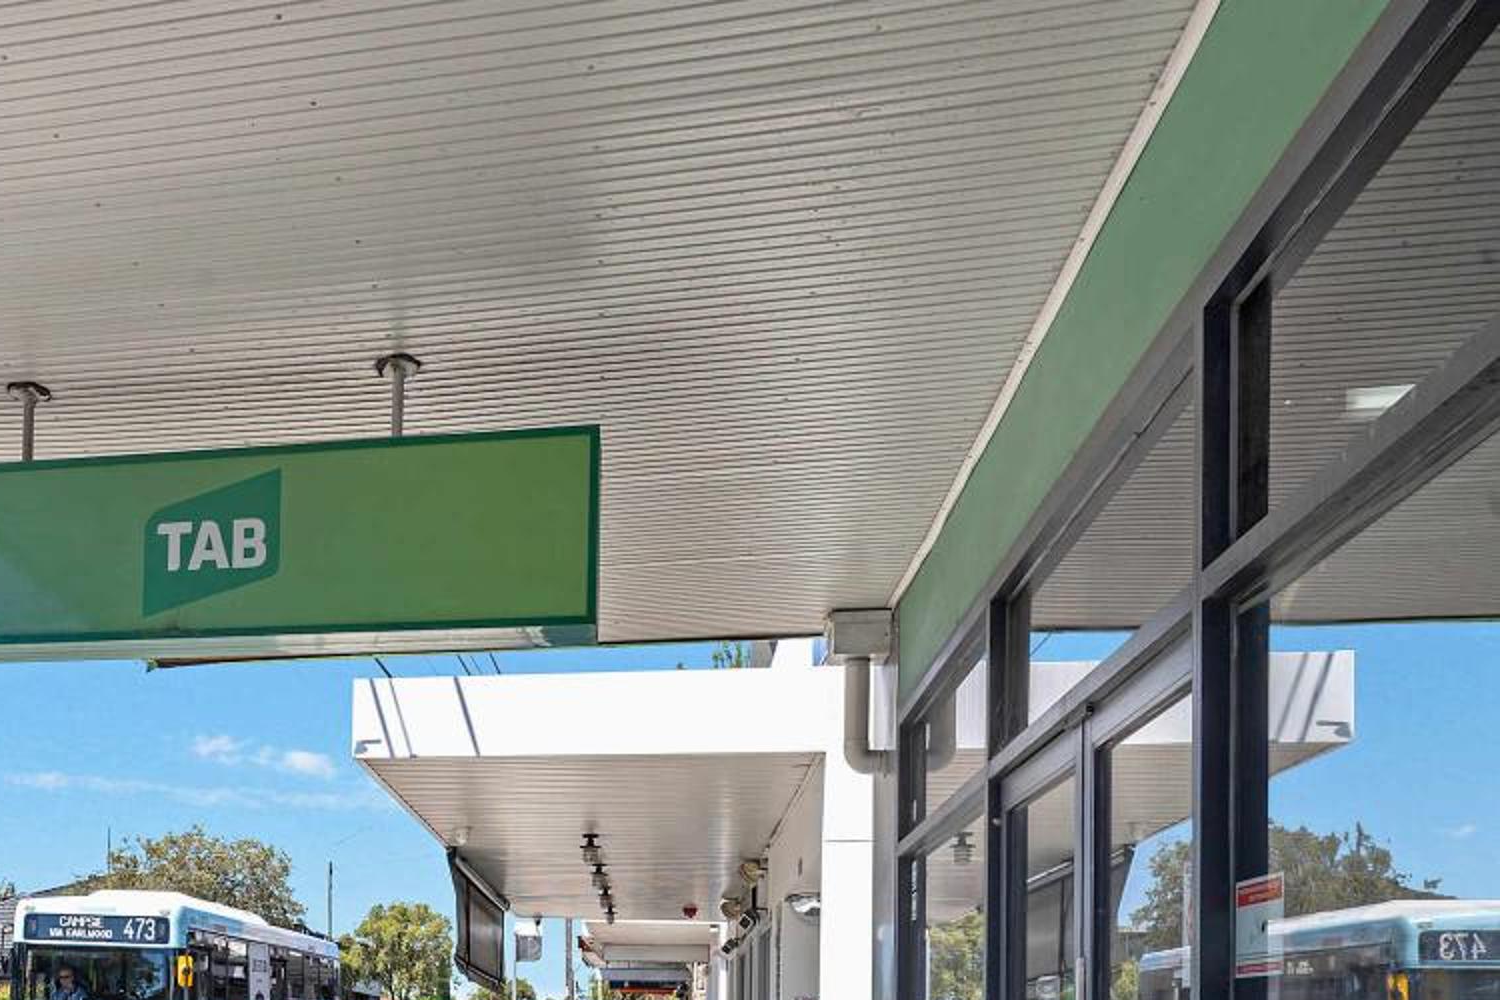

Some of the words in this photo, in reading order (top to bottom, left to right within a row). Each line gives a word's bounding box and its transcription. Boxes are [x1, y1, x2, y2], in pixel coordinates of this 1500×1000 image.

[157, 518, 267, 571] TAB
[49, 928, 64, 937] VIA
[124, 918, 156, 940] 473
